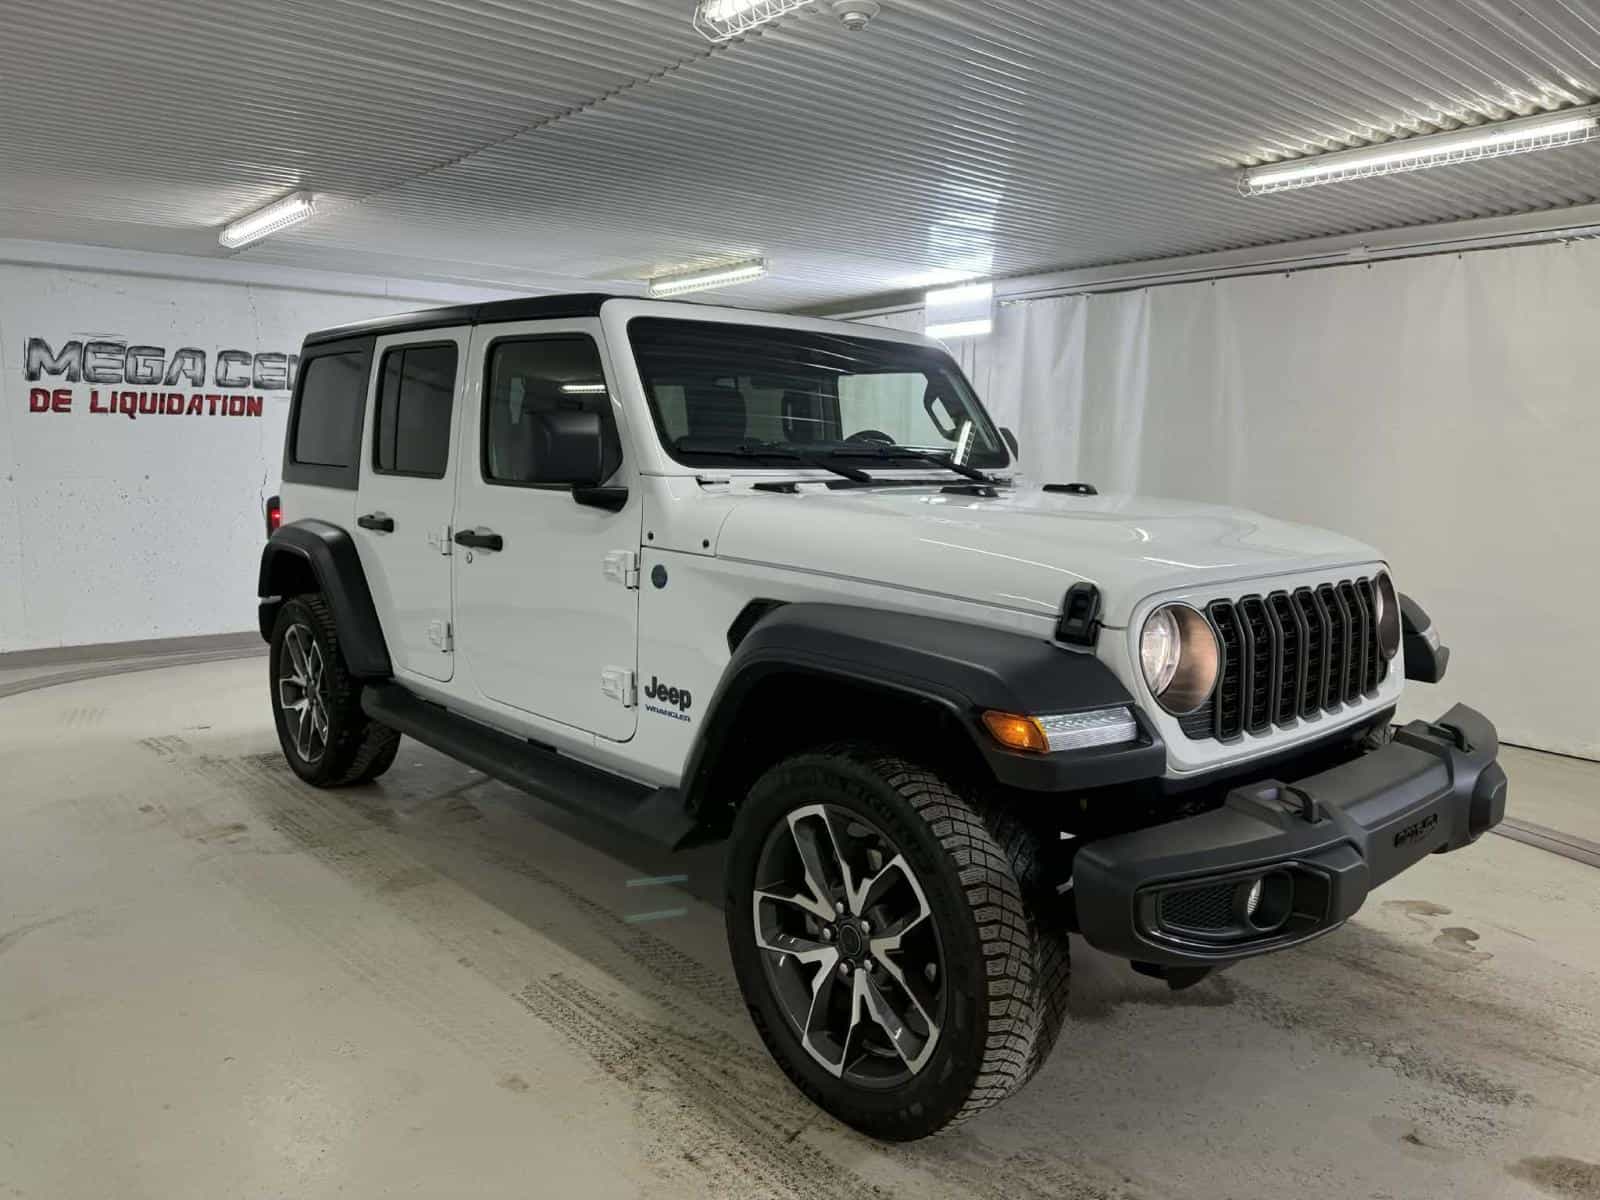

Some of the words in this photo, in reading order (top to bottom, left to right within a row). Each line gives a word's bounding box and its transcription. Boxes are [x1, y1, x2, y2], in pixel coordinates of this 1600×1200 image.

[29, 388, 73, 413] DE
[89, 389, 264, 420] LIQUIDATION
[645, 676, 691, 712] Jeep
